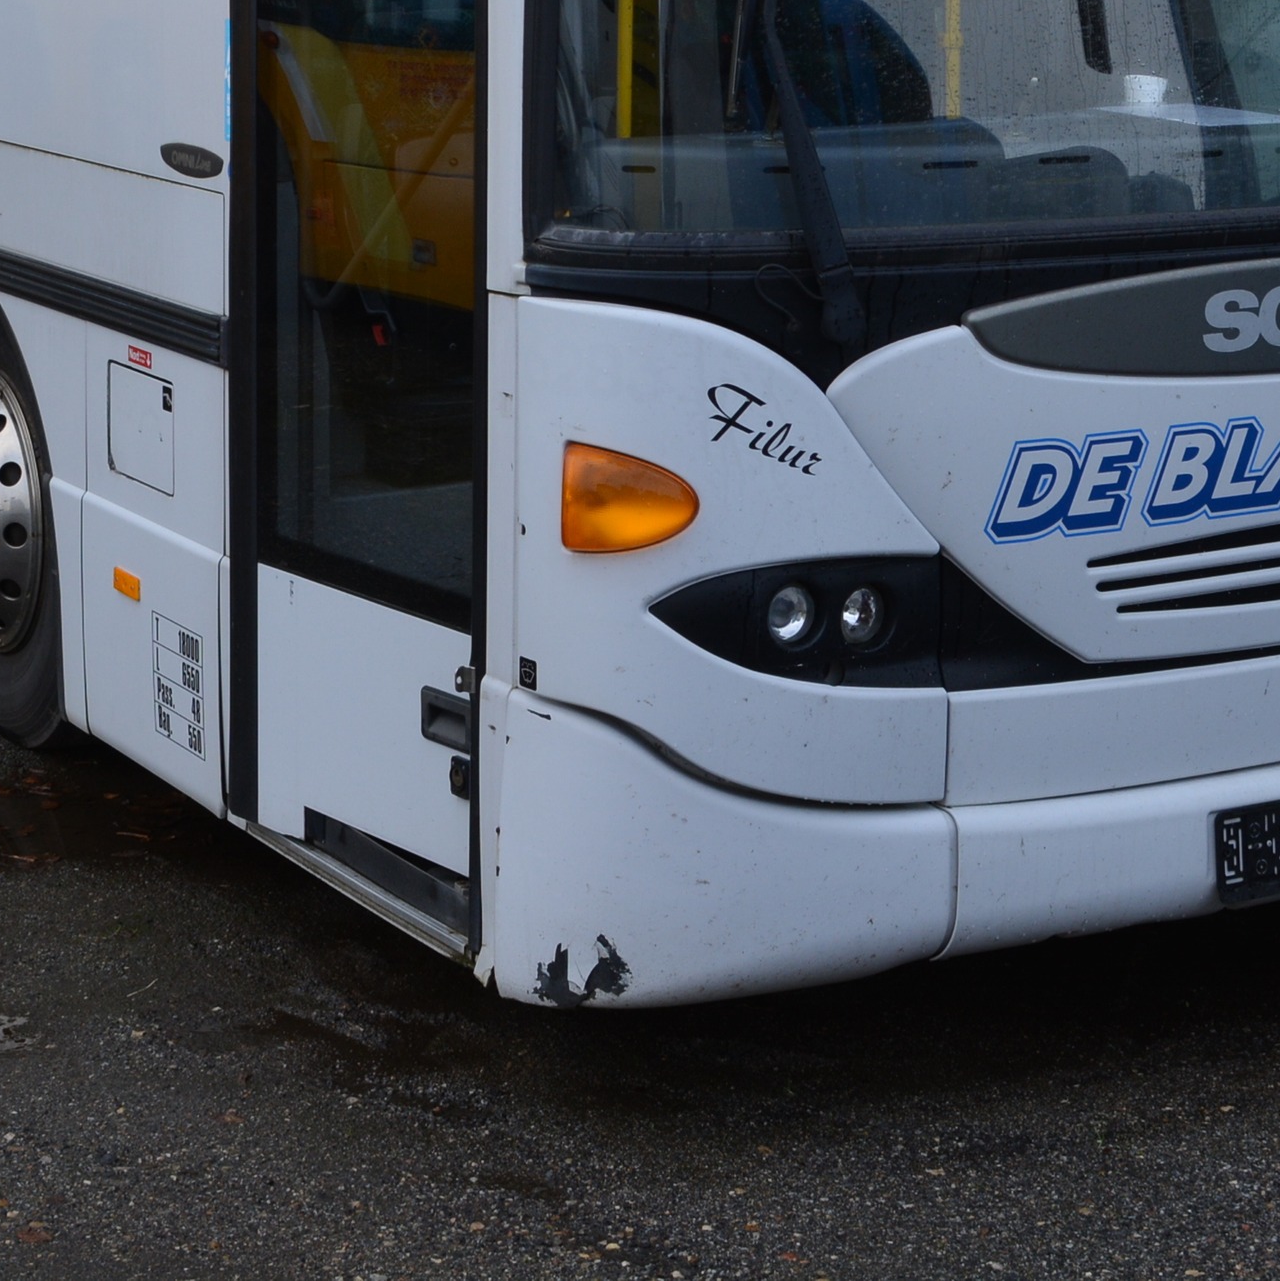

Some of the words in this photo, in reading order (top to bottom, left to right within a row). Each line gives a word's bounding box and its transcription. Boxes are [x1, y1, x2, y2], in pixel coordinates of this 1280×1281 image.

[706, 382, 822, 476] Filur
[984, 428, 1148, 544] DE
[178, 630, 200, 663] 18000
[157, 677, 176, 709] Pass.
[181, 662, 200, 694] 6550
[158, 705, 173, 737] Bag.
[187, 724, 202, 754] 550
